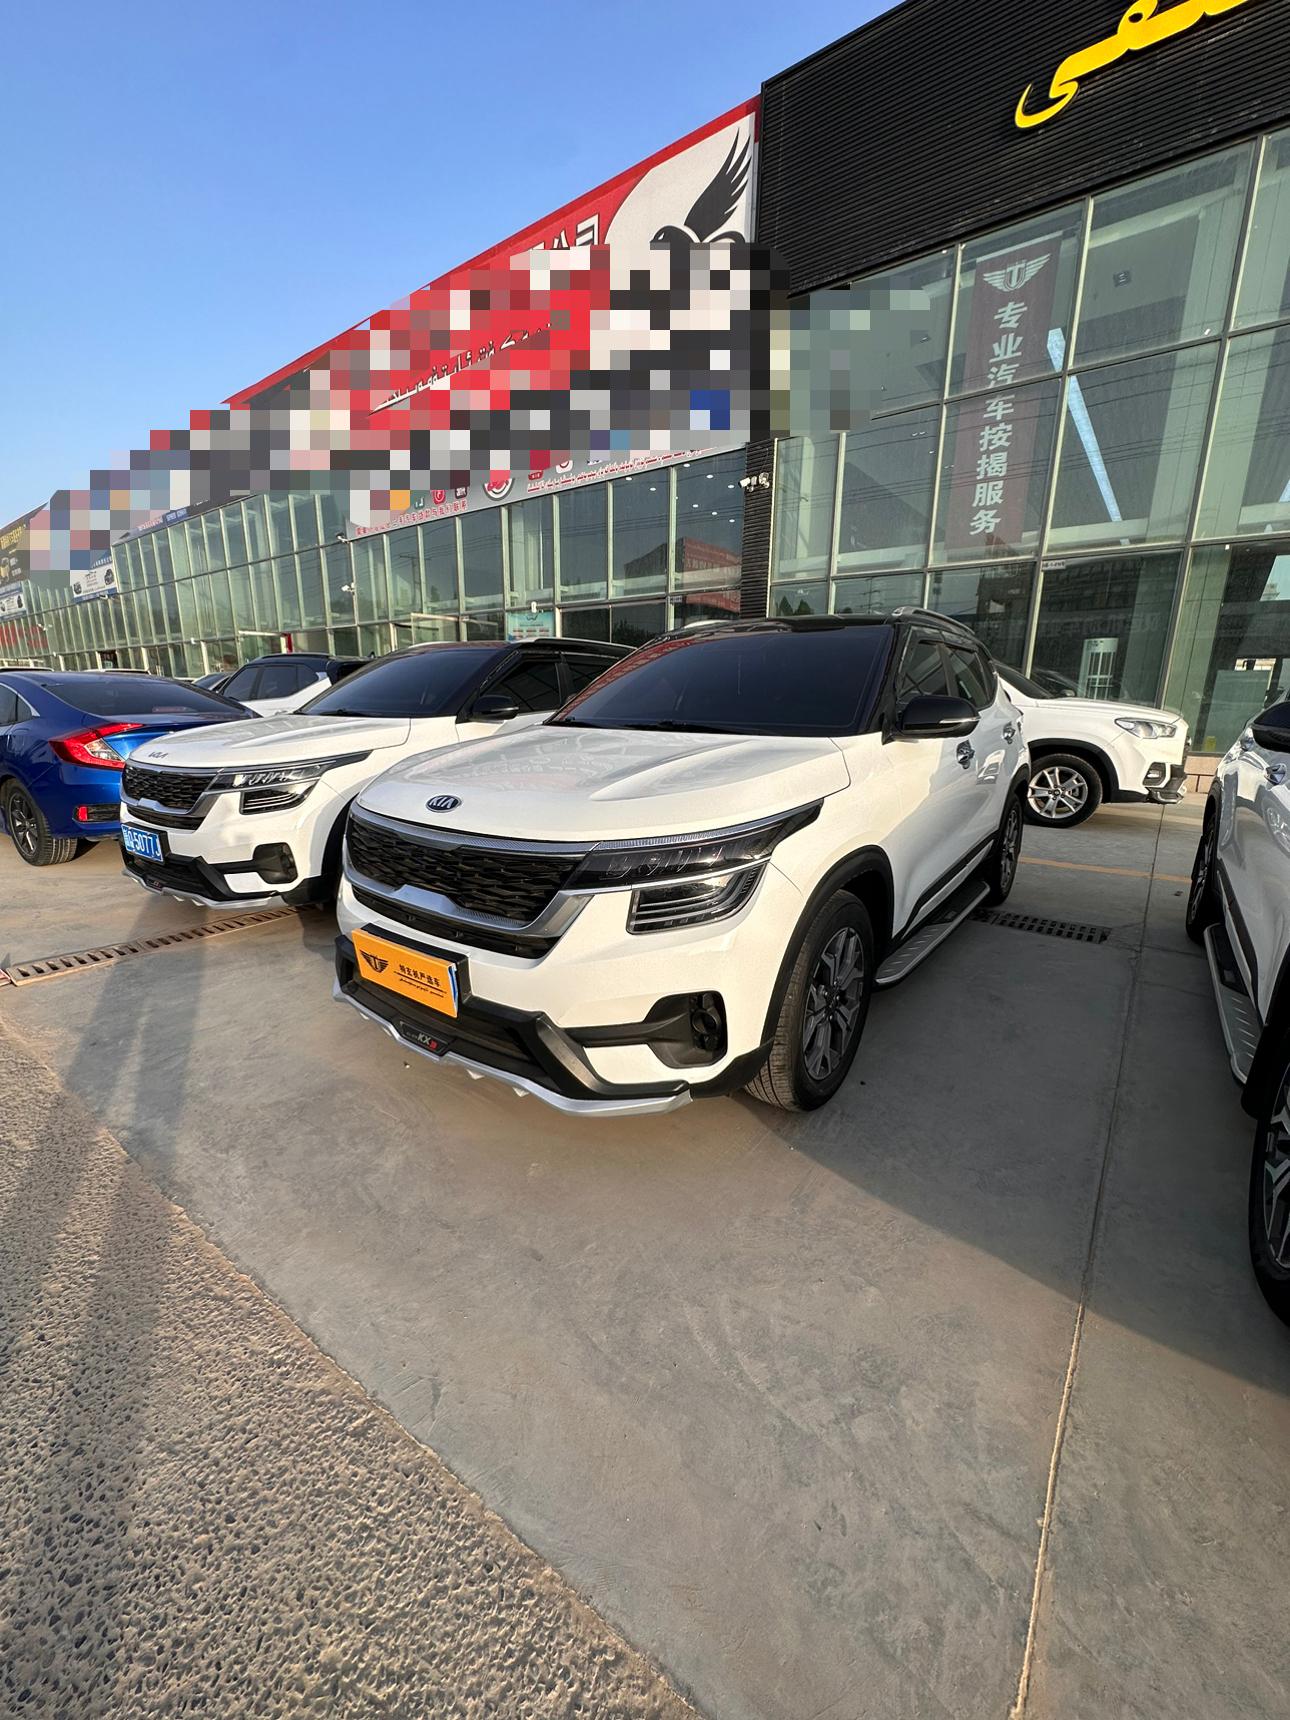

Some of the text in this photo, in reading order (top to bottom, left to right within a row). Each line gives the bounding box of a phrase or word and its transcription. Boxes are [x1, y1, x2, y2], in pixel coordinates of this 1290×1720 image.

[969, 301, 1028, 536] 专业汽车按揭服务
[429, 796, 455, 809] KIA
